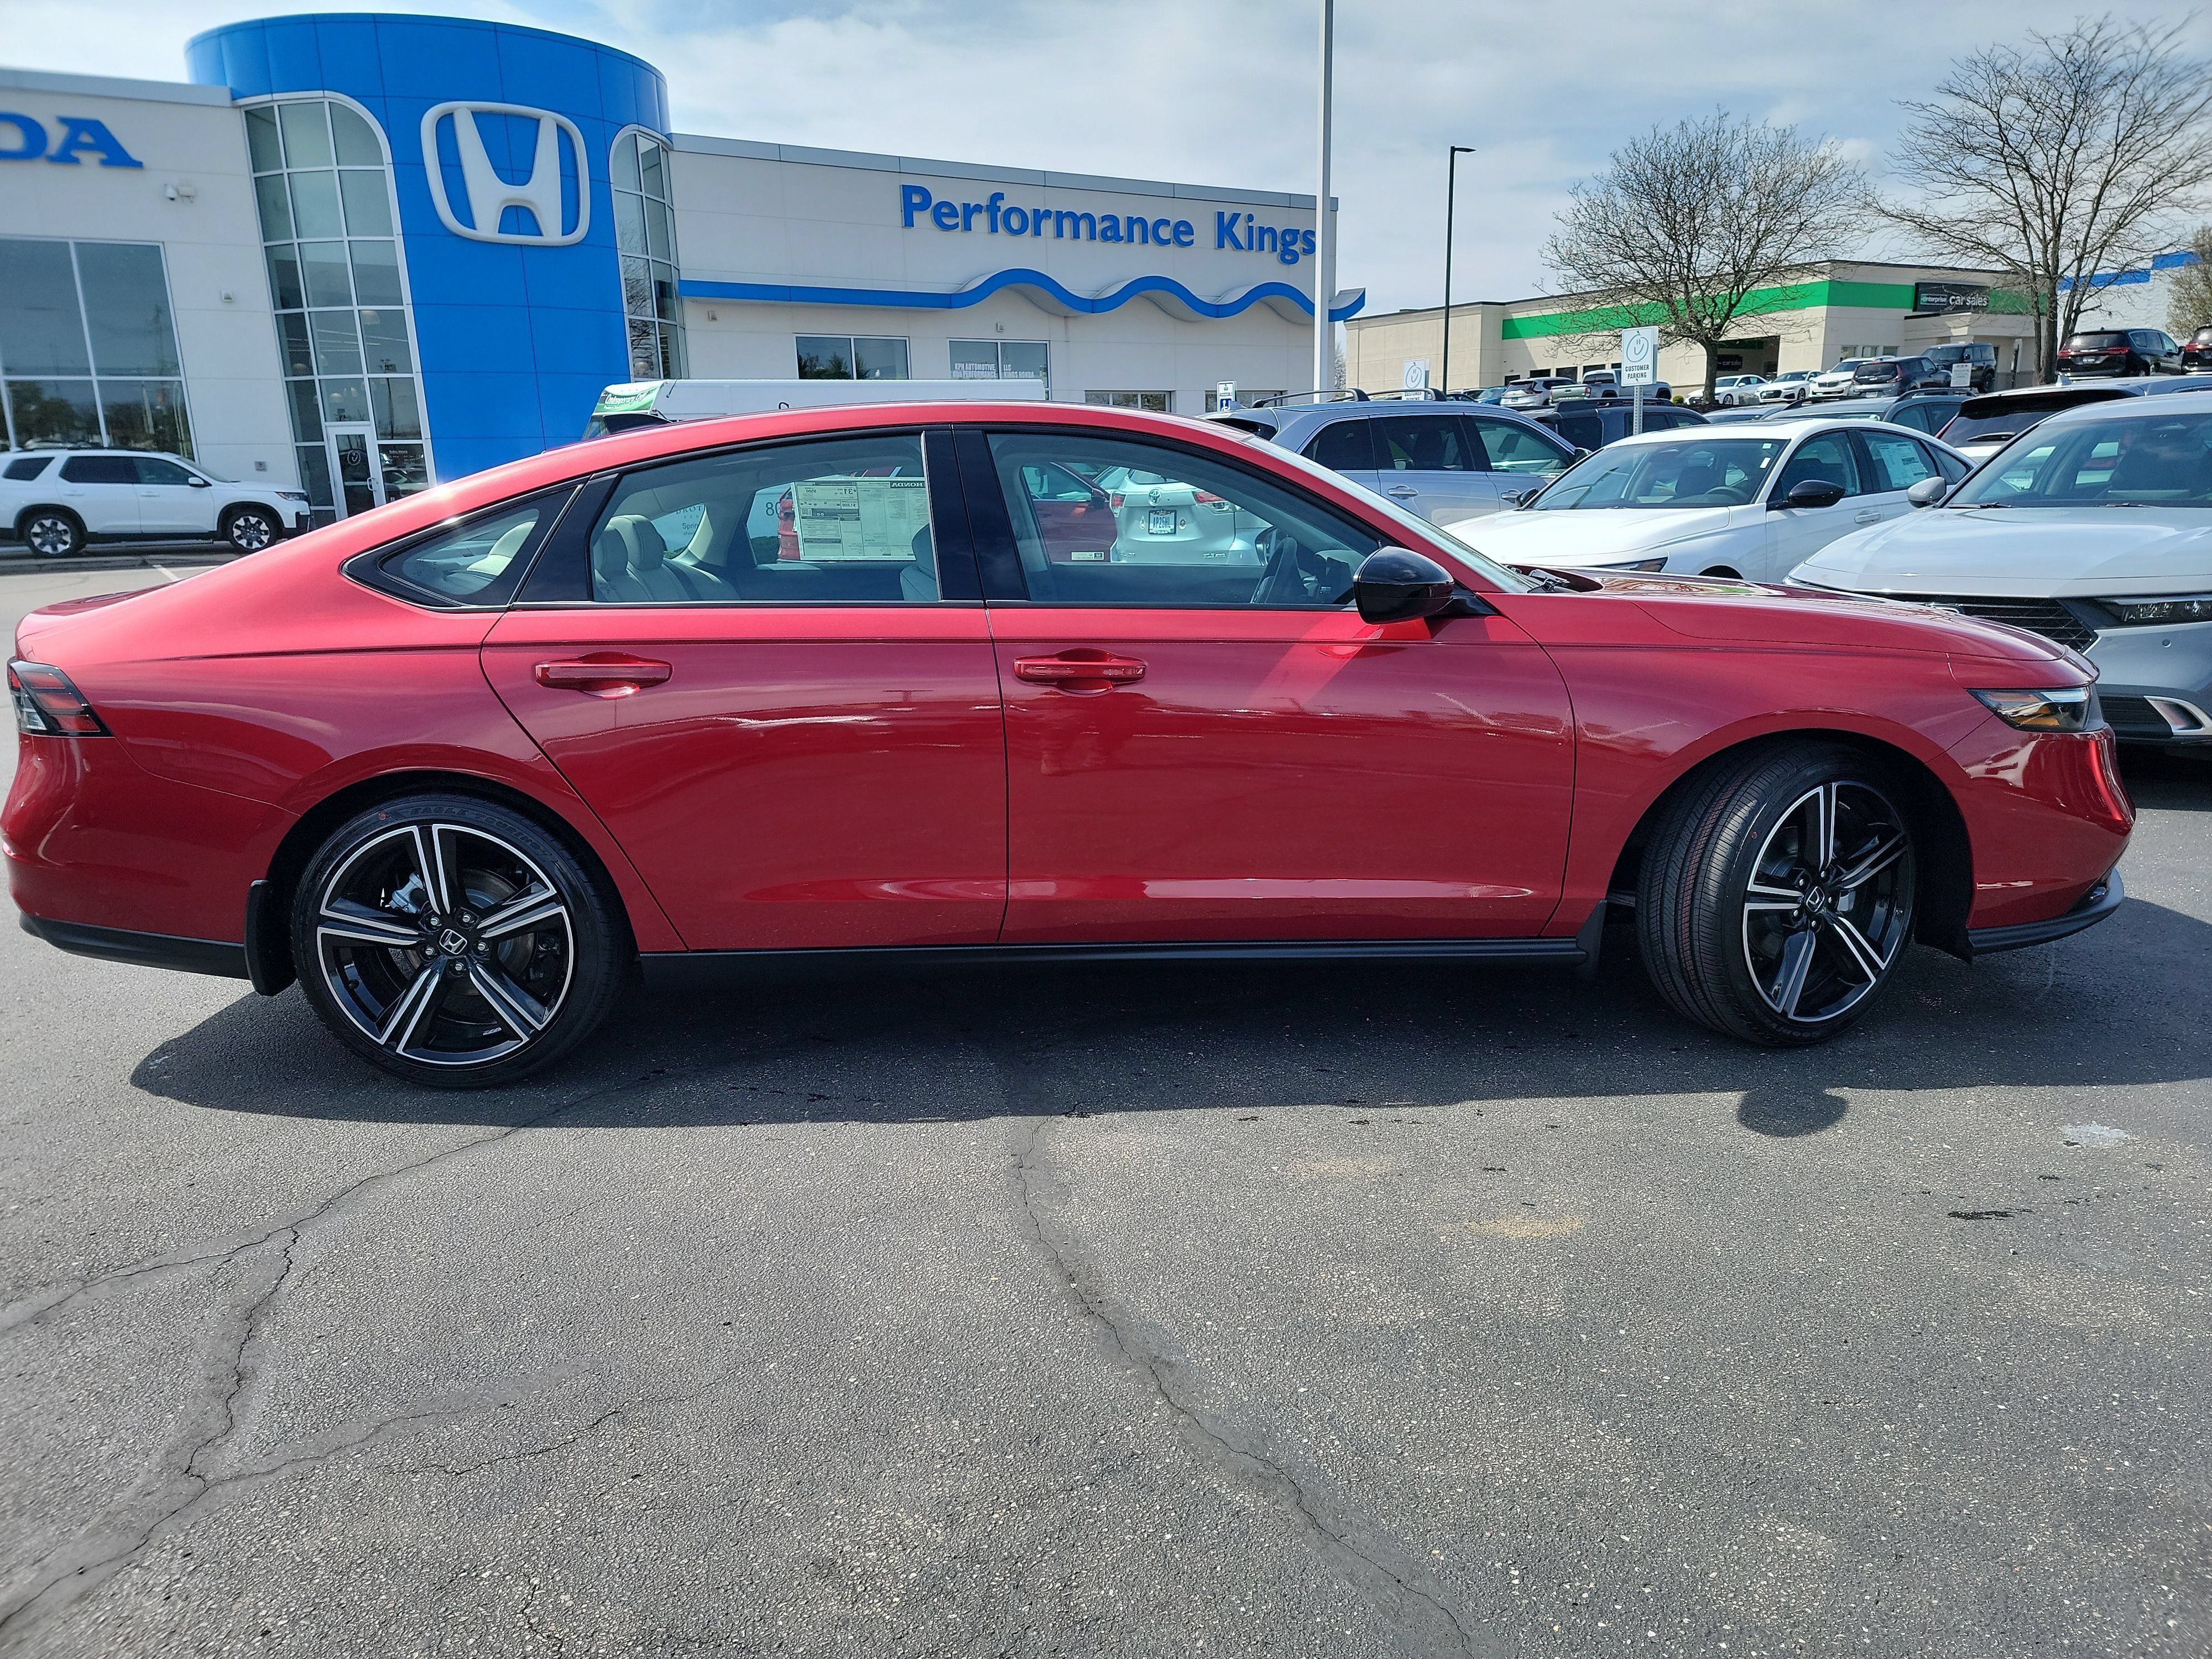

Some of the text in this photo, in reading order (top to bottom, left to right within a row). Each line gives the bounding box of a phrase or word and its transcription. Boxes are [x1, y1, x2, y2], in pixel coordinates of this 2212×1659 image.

[900, 184, 1316, 265] Performance Kings
[1949, 296, 1964, 305] car
[1966, 294, 1987, 306] sales
